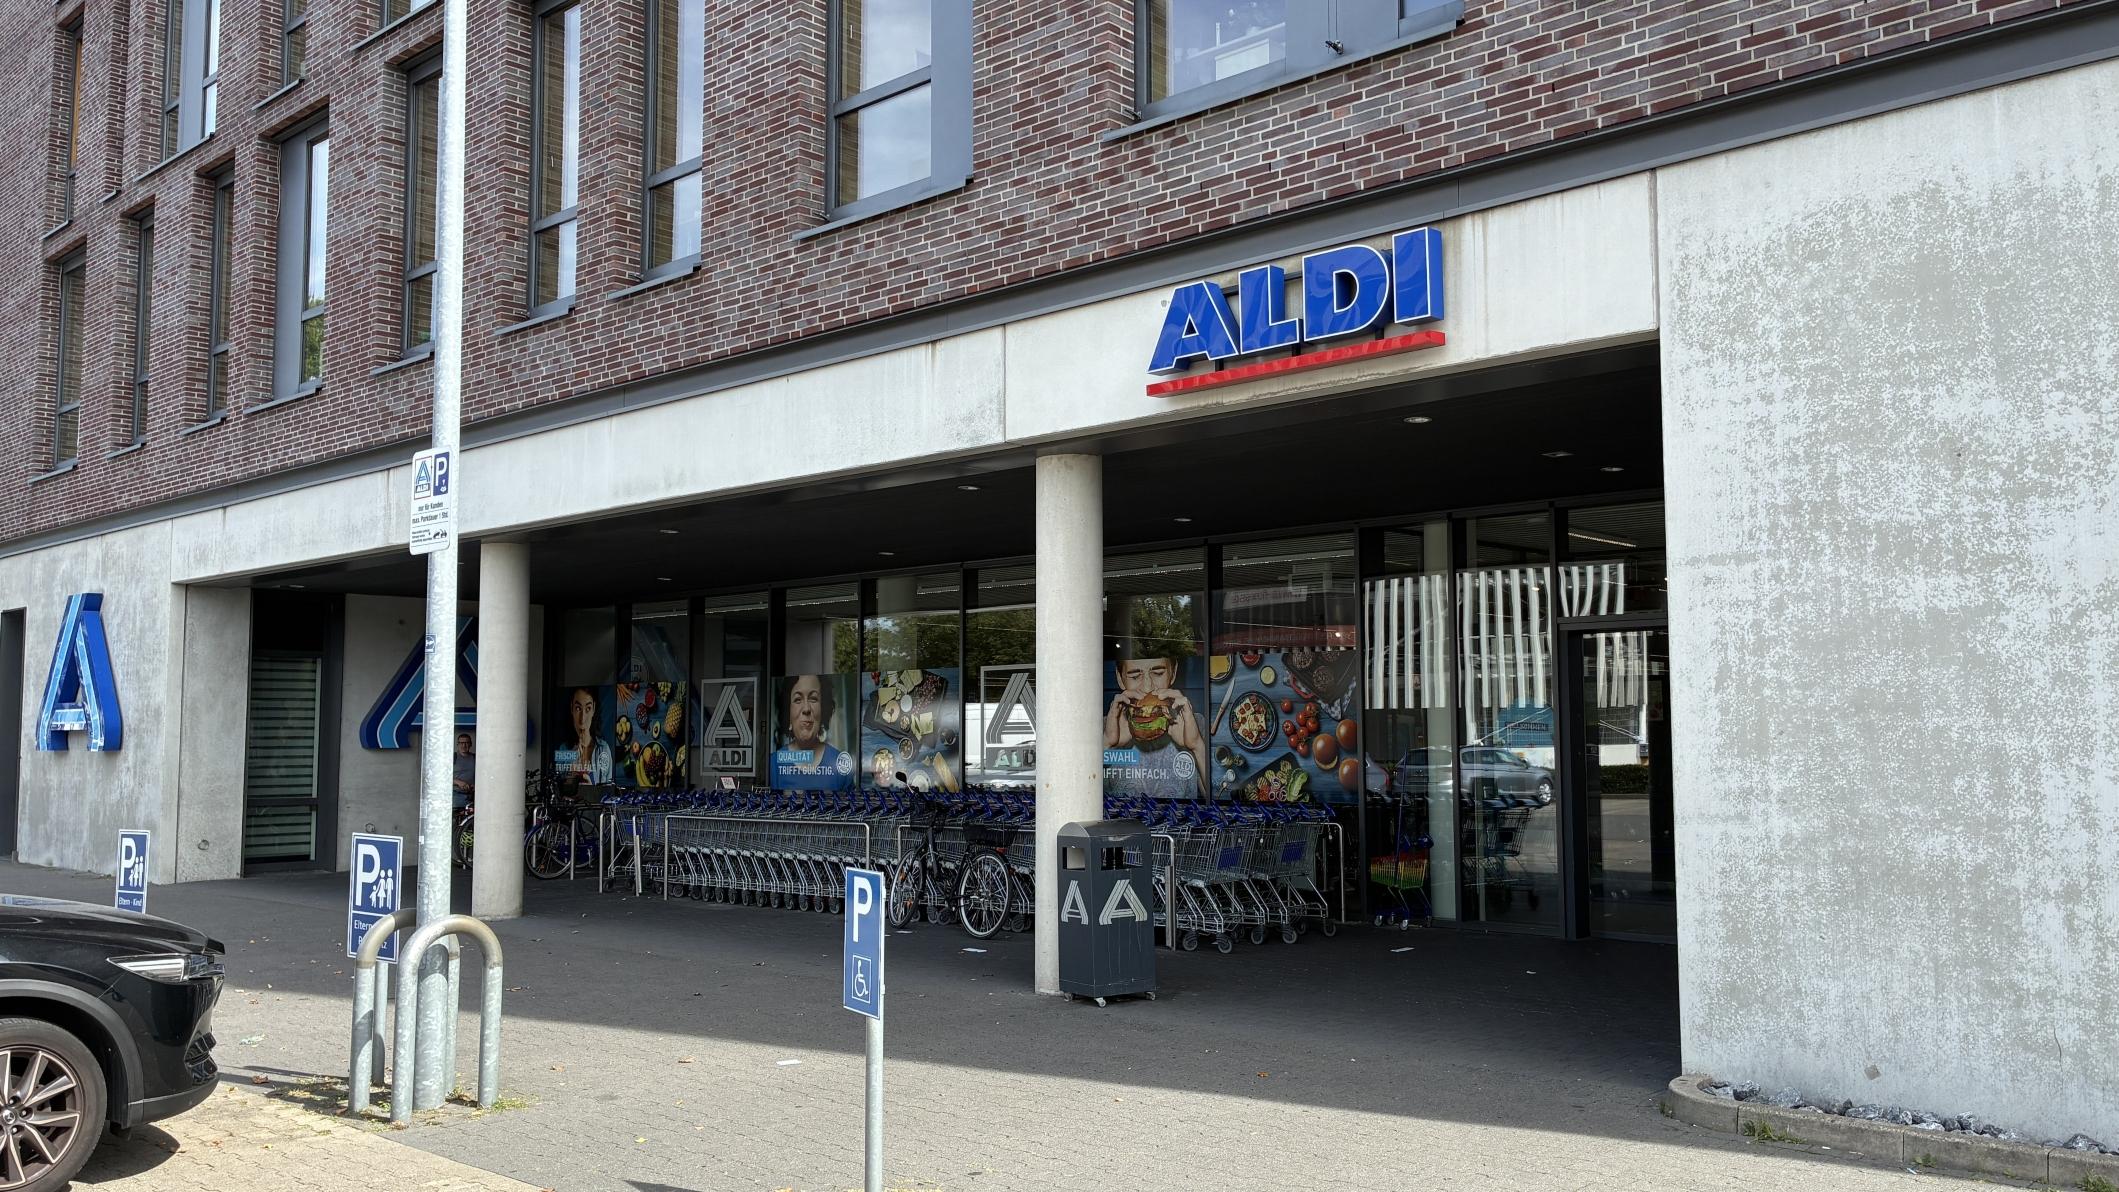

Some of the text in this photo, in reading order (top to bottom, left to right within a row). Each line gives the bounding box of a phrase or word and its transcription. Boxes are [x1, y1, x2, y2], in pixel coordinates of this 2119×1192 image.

[1147, 227, 1444, 376] ALDI
[435, 456, 447, 486] P
[556, 751, 577, 760] FRISCHE
[709, 750, 747, 766] ALDI
[1103, 751, 1137, 762] SWAHL
[778, 766, 801, 775] TRIFFT
[802, 764, 834, 776] GÜNSTIG.
[1175, 759, 1192, 769] ALDI
[1125, 768, 1170, 780] EINFACH.
[119, 837, 136, 887] P
[355, 843, 380, 907] P
[852, 875, 873, 943] P
